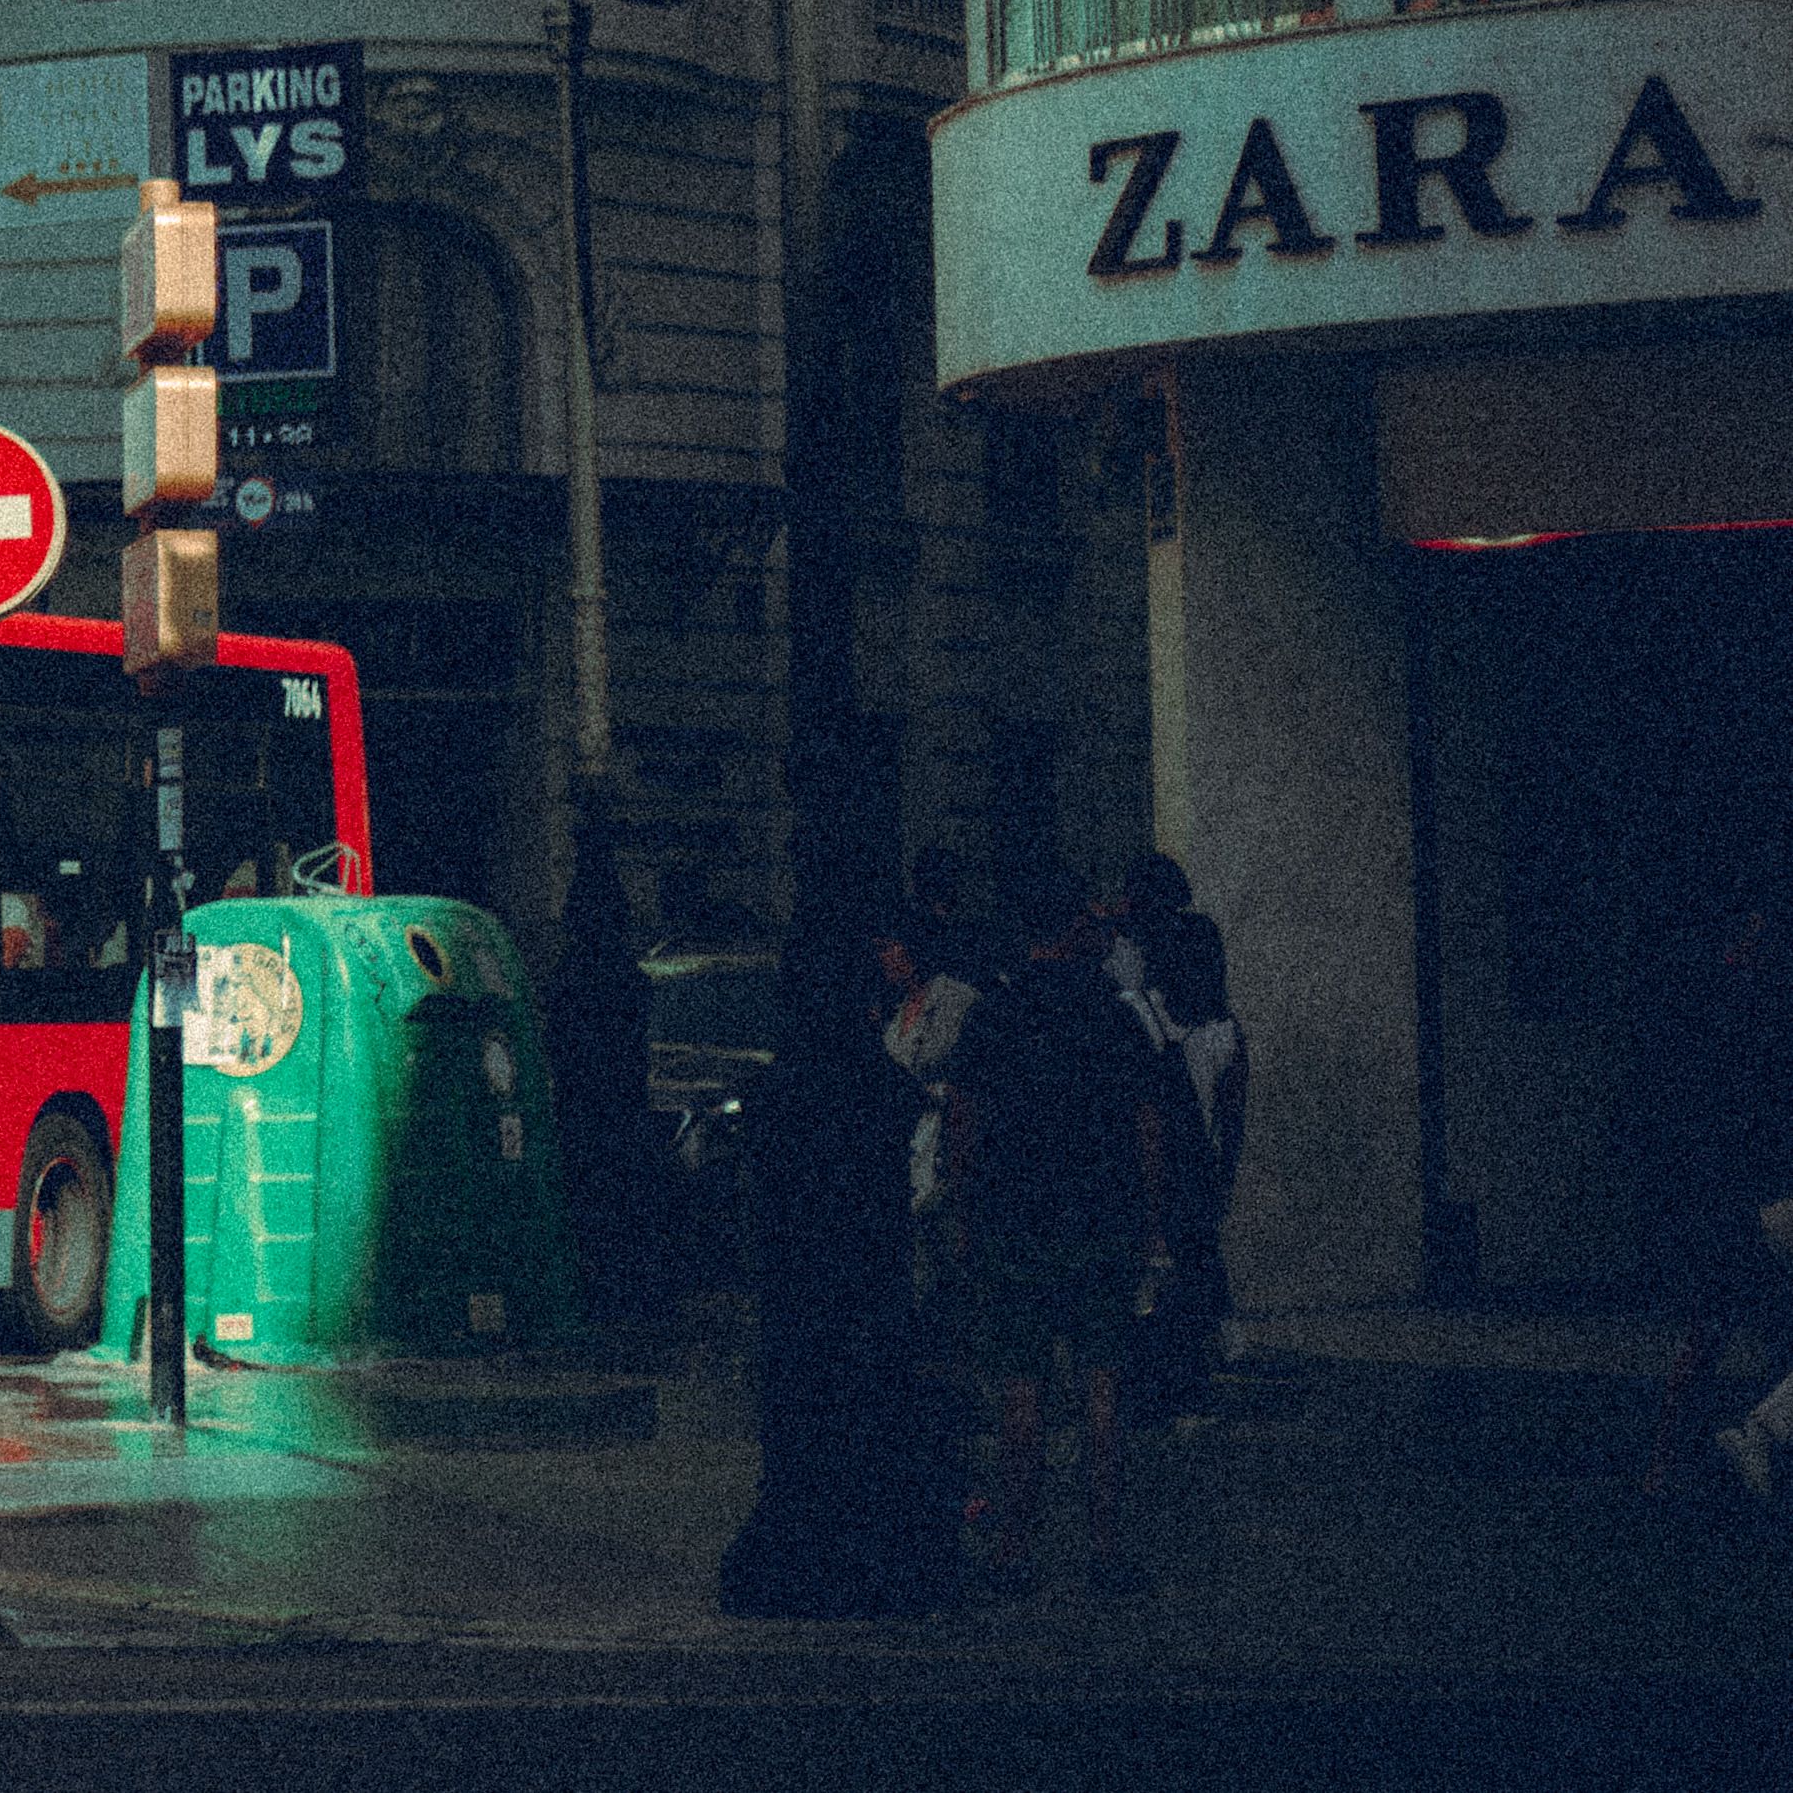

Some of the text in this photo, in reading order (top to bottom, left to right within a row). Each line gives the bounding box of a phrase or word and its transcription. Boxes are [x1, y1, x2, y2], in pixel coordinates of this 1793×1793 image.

[183, 65, 343, 117] PARKING
[187, 121, 346, 186] LYS
[1086, 74, 1764, 278] ZARA
[226, 247, 303, 362] P
